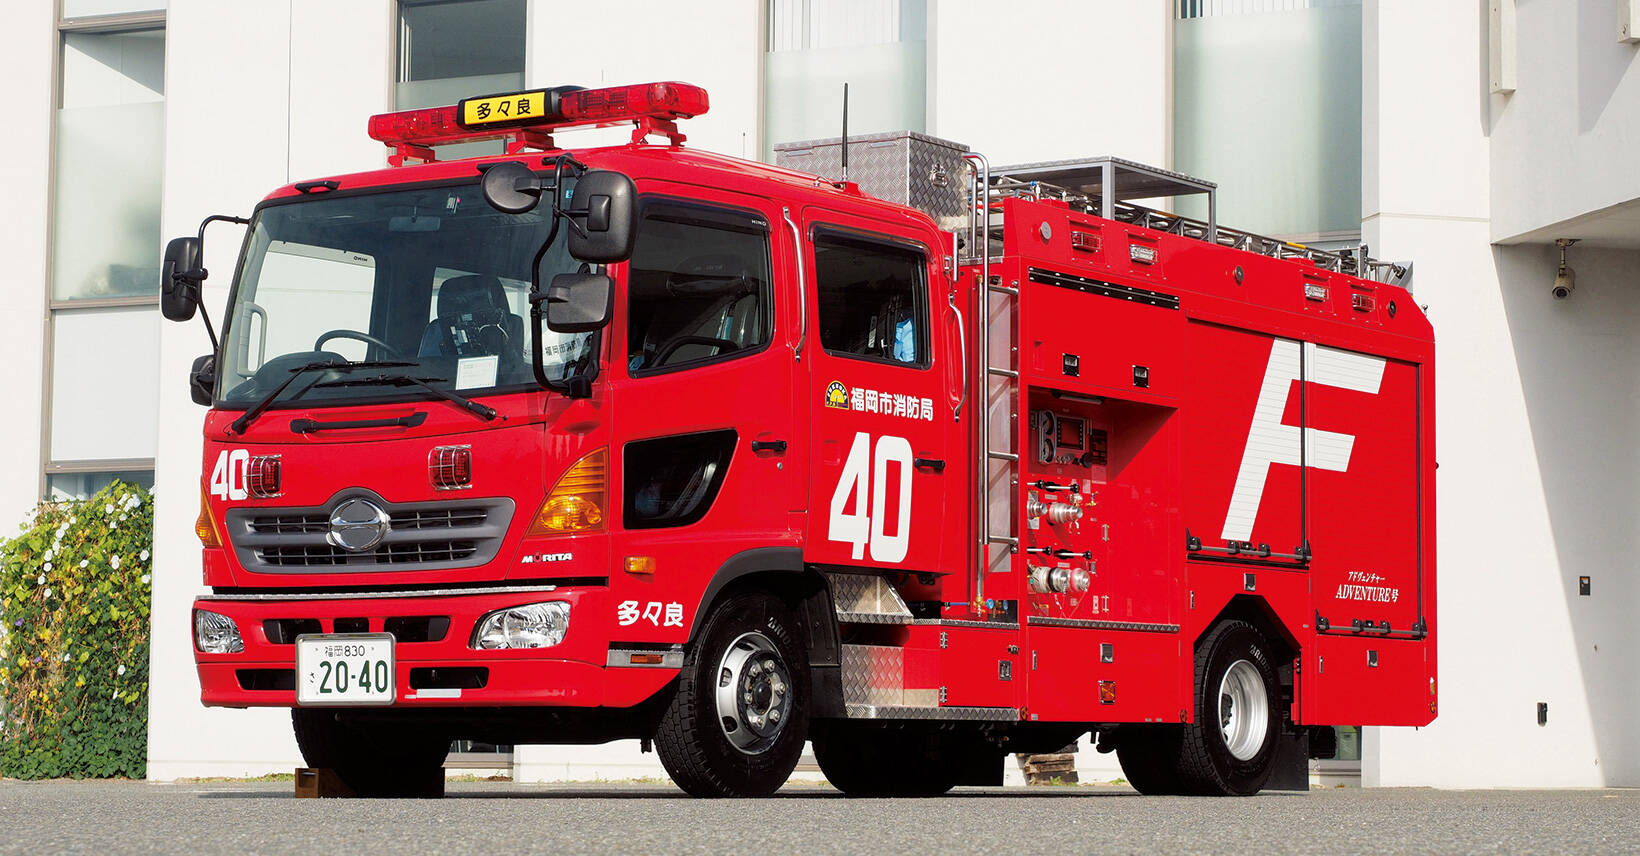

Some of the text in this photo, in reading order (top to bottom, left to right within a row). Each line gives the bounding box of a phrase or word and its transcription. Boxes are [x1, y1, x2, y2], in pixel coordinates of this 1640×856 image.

[477, 98, 531, 120] 多々良
[851, 387, 934, 421] 福岡市消防局
[1221, 337, 1386, 541] F
[210, 448, 250, 501] 40
[828, 431, 913, 563] 40
[521, 551, 573, 563] MORITA
[617, 600, 684, 627] 多々良
